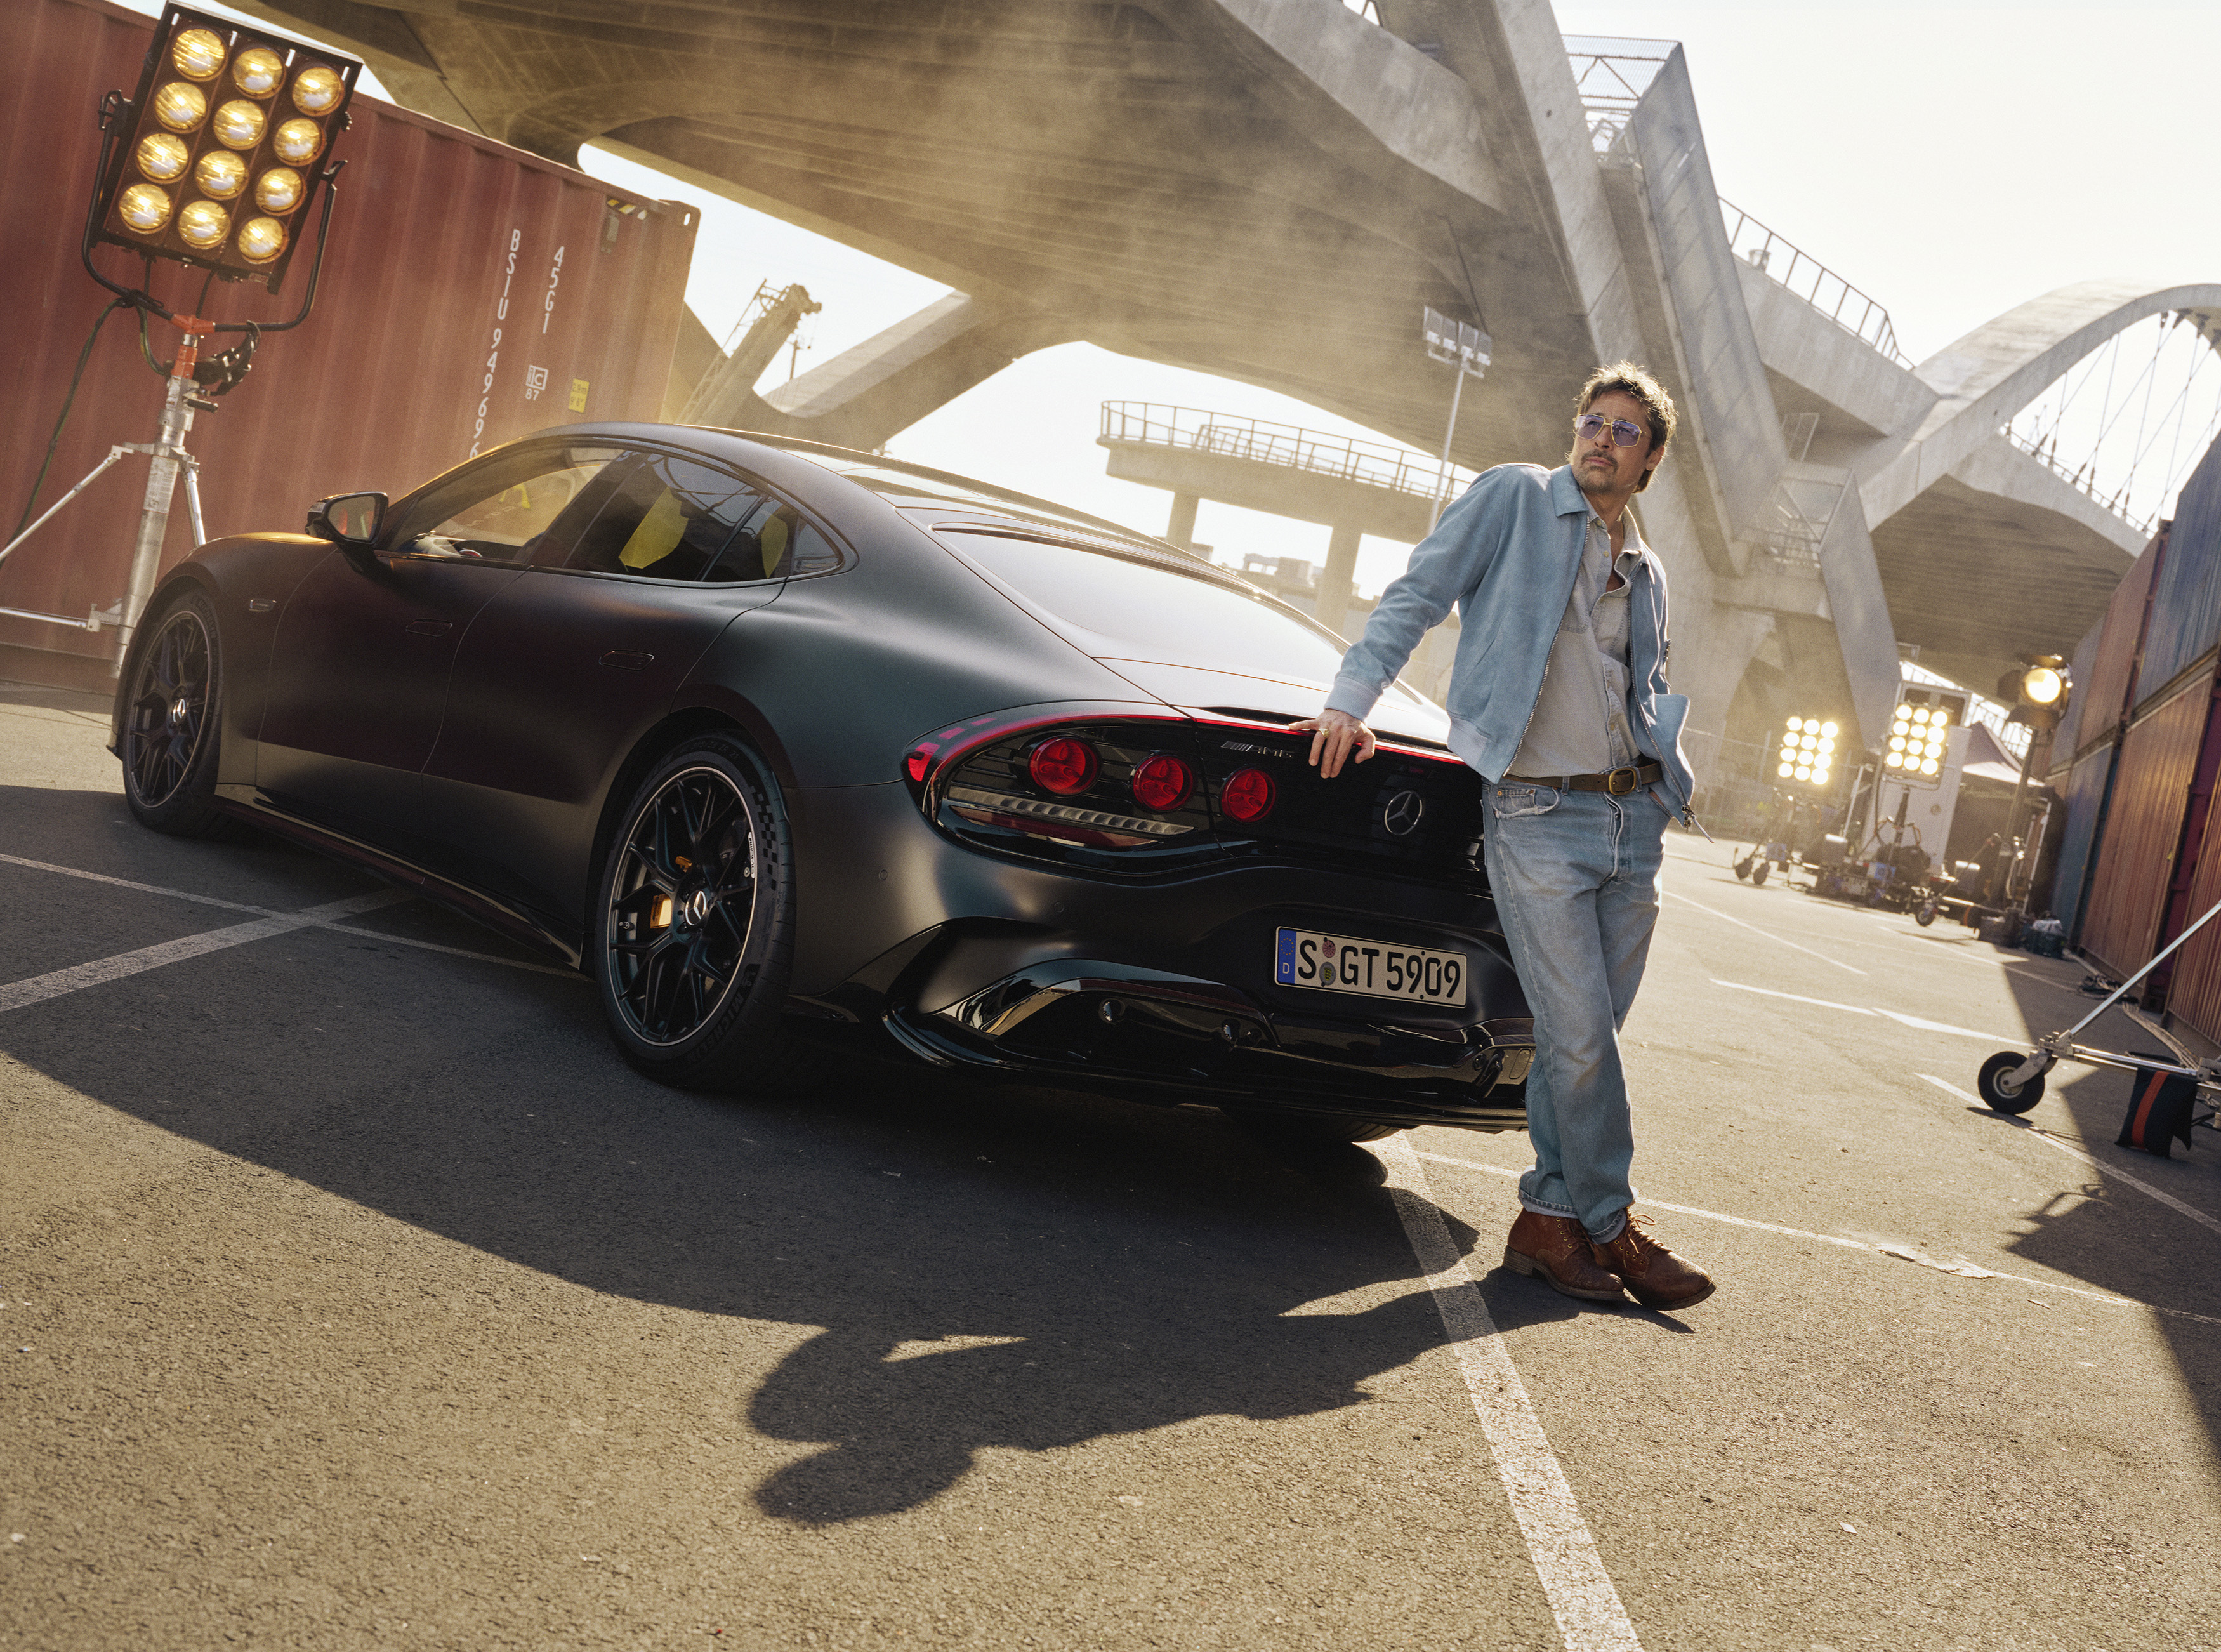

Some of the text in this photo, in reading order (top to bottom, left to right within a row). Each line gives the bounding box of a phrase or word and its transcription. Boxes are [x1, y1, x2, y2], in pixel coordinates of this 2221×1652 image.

[543, 246, 564, 334] 45G1
[470, 229, 520, 459] BSIU 949696
[525, 388, 539, 400] 87
[1245, 744, 1295, 759] AMG
[1282, 962, 1290, 975] D
[1298, 939, 1460, 998] S GT 5909
[687, 992, 745, 1064] MICHELIN
